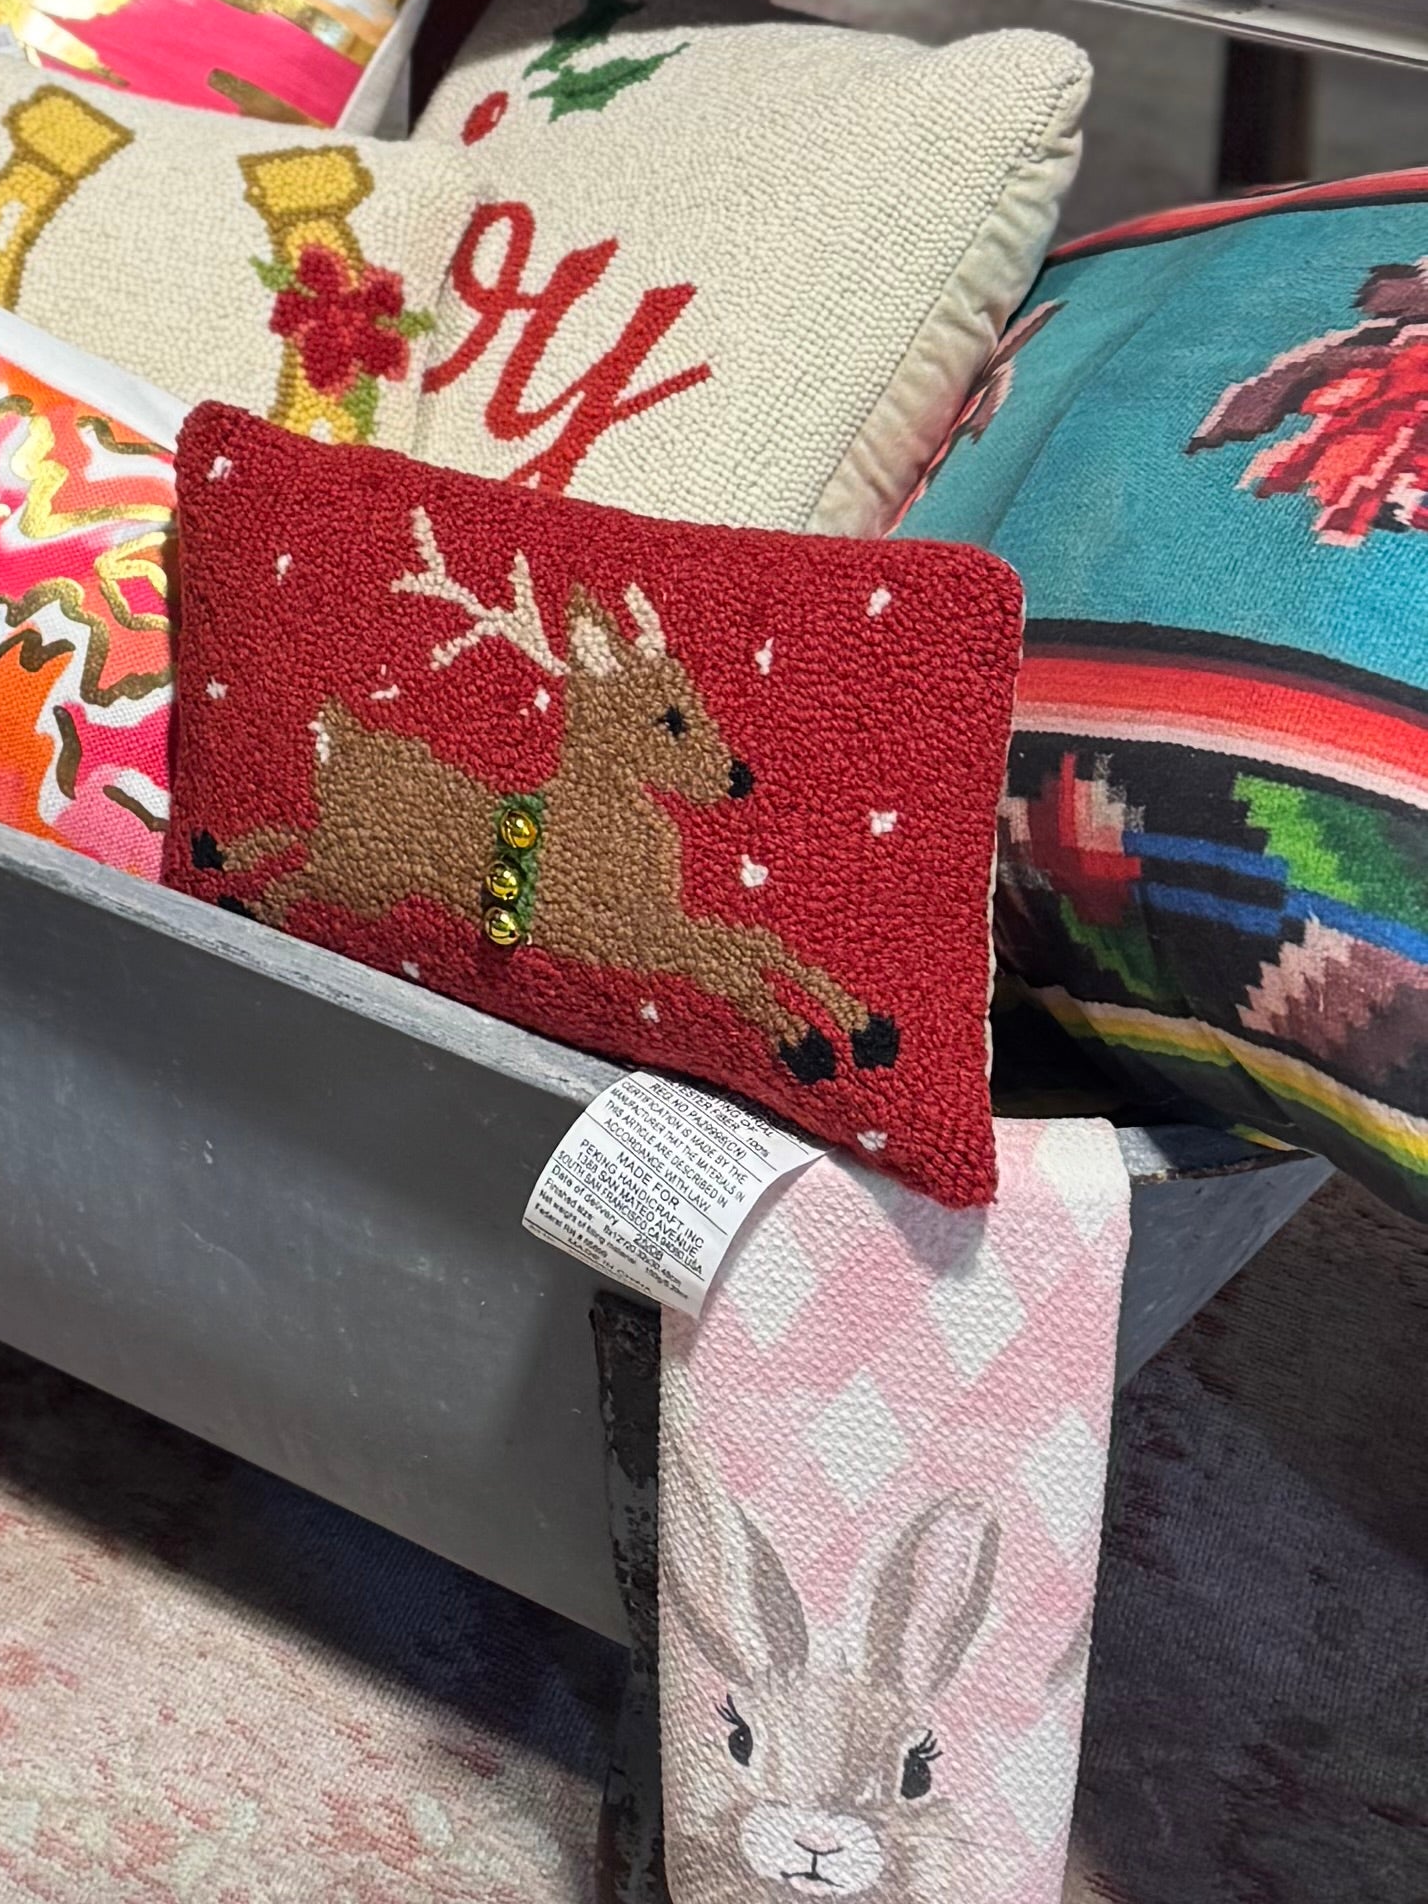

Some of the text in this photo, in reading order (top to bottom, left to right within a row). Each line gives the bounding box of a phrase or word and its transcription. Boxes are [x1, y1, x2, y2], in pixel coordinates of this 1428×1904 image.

[604, 1116, 666, 1173] ACCORDANCE
[663, 1168, 690, 1194] WITH
[605, 1099, 729, 1209] THIS ARTICLE ARE DESCRIBED IN
[610, 1086, 746, 1203] MANUFACTURER THAT THE MATERIALS IN
[621, 1079, 749, 1186] CERTIFICATION IS MADE BY THE
[544, 1177, 578, 1208] Finished
[550, 1164, 575, 1188] Date
[573, 1184, 585, 1196] of
[583, 1192, 620, 1227] delivery
[557, 1149, 586, 1177] SOUTH
[583, 1173, 603, 1192] SAN
[601, 1187, 649, 1231] FRANCISCO
[646, 1226, 662, 1242] CA
[579, 1138, 619, 1176] PEKING
[617, 1172, 685, 1232] HANDICRAFT
[597, 1169, 621, 1192] SAN
[618, 1188, 657, 1223] MATEO
[654, 1218, 700, 1258] AVENUE
[616, 1151, 682, 1210] MADE FOR
